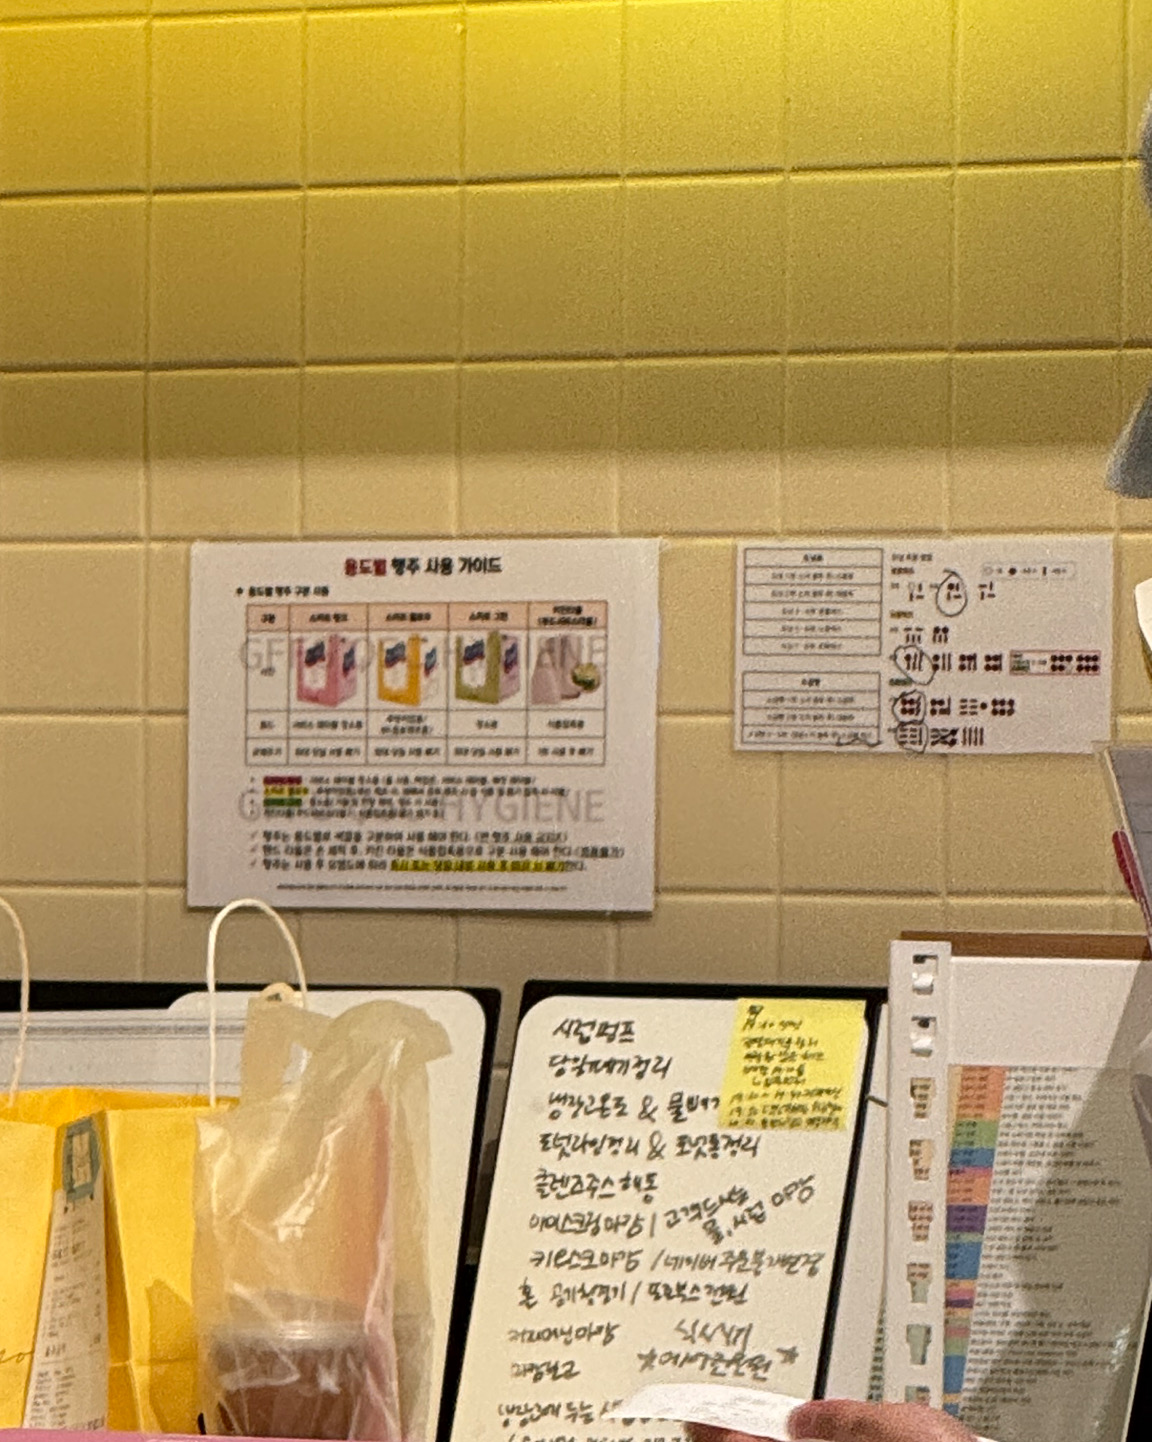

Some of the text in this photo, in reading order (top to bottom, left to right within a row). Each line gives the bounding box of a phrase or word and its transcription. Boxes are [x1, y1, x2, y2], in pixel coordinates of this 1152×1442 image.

[344, 556, 503, 576] 용도별 행주 사용 가이드
[552, 1018, 635, 1044] 시럽펌프
[637, 1094, 659, 1123] &
[646, 1130, 667, 1161] &
